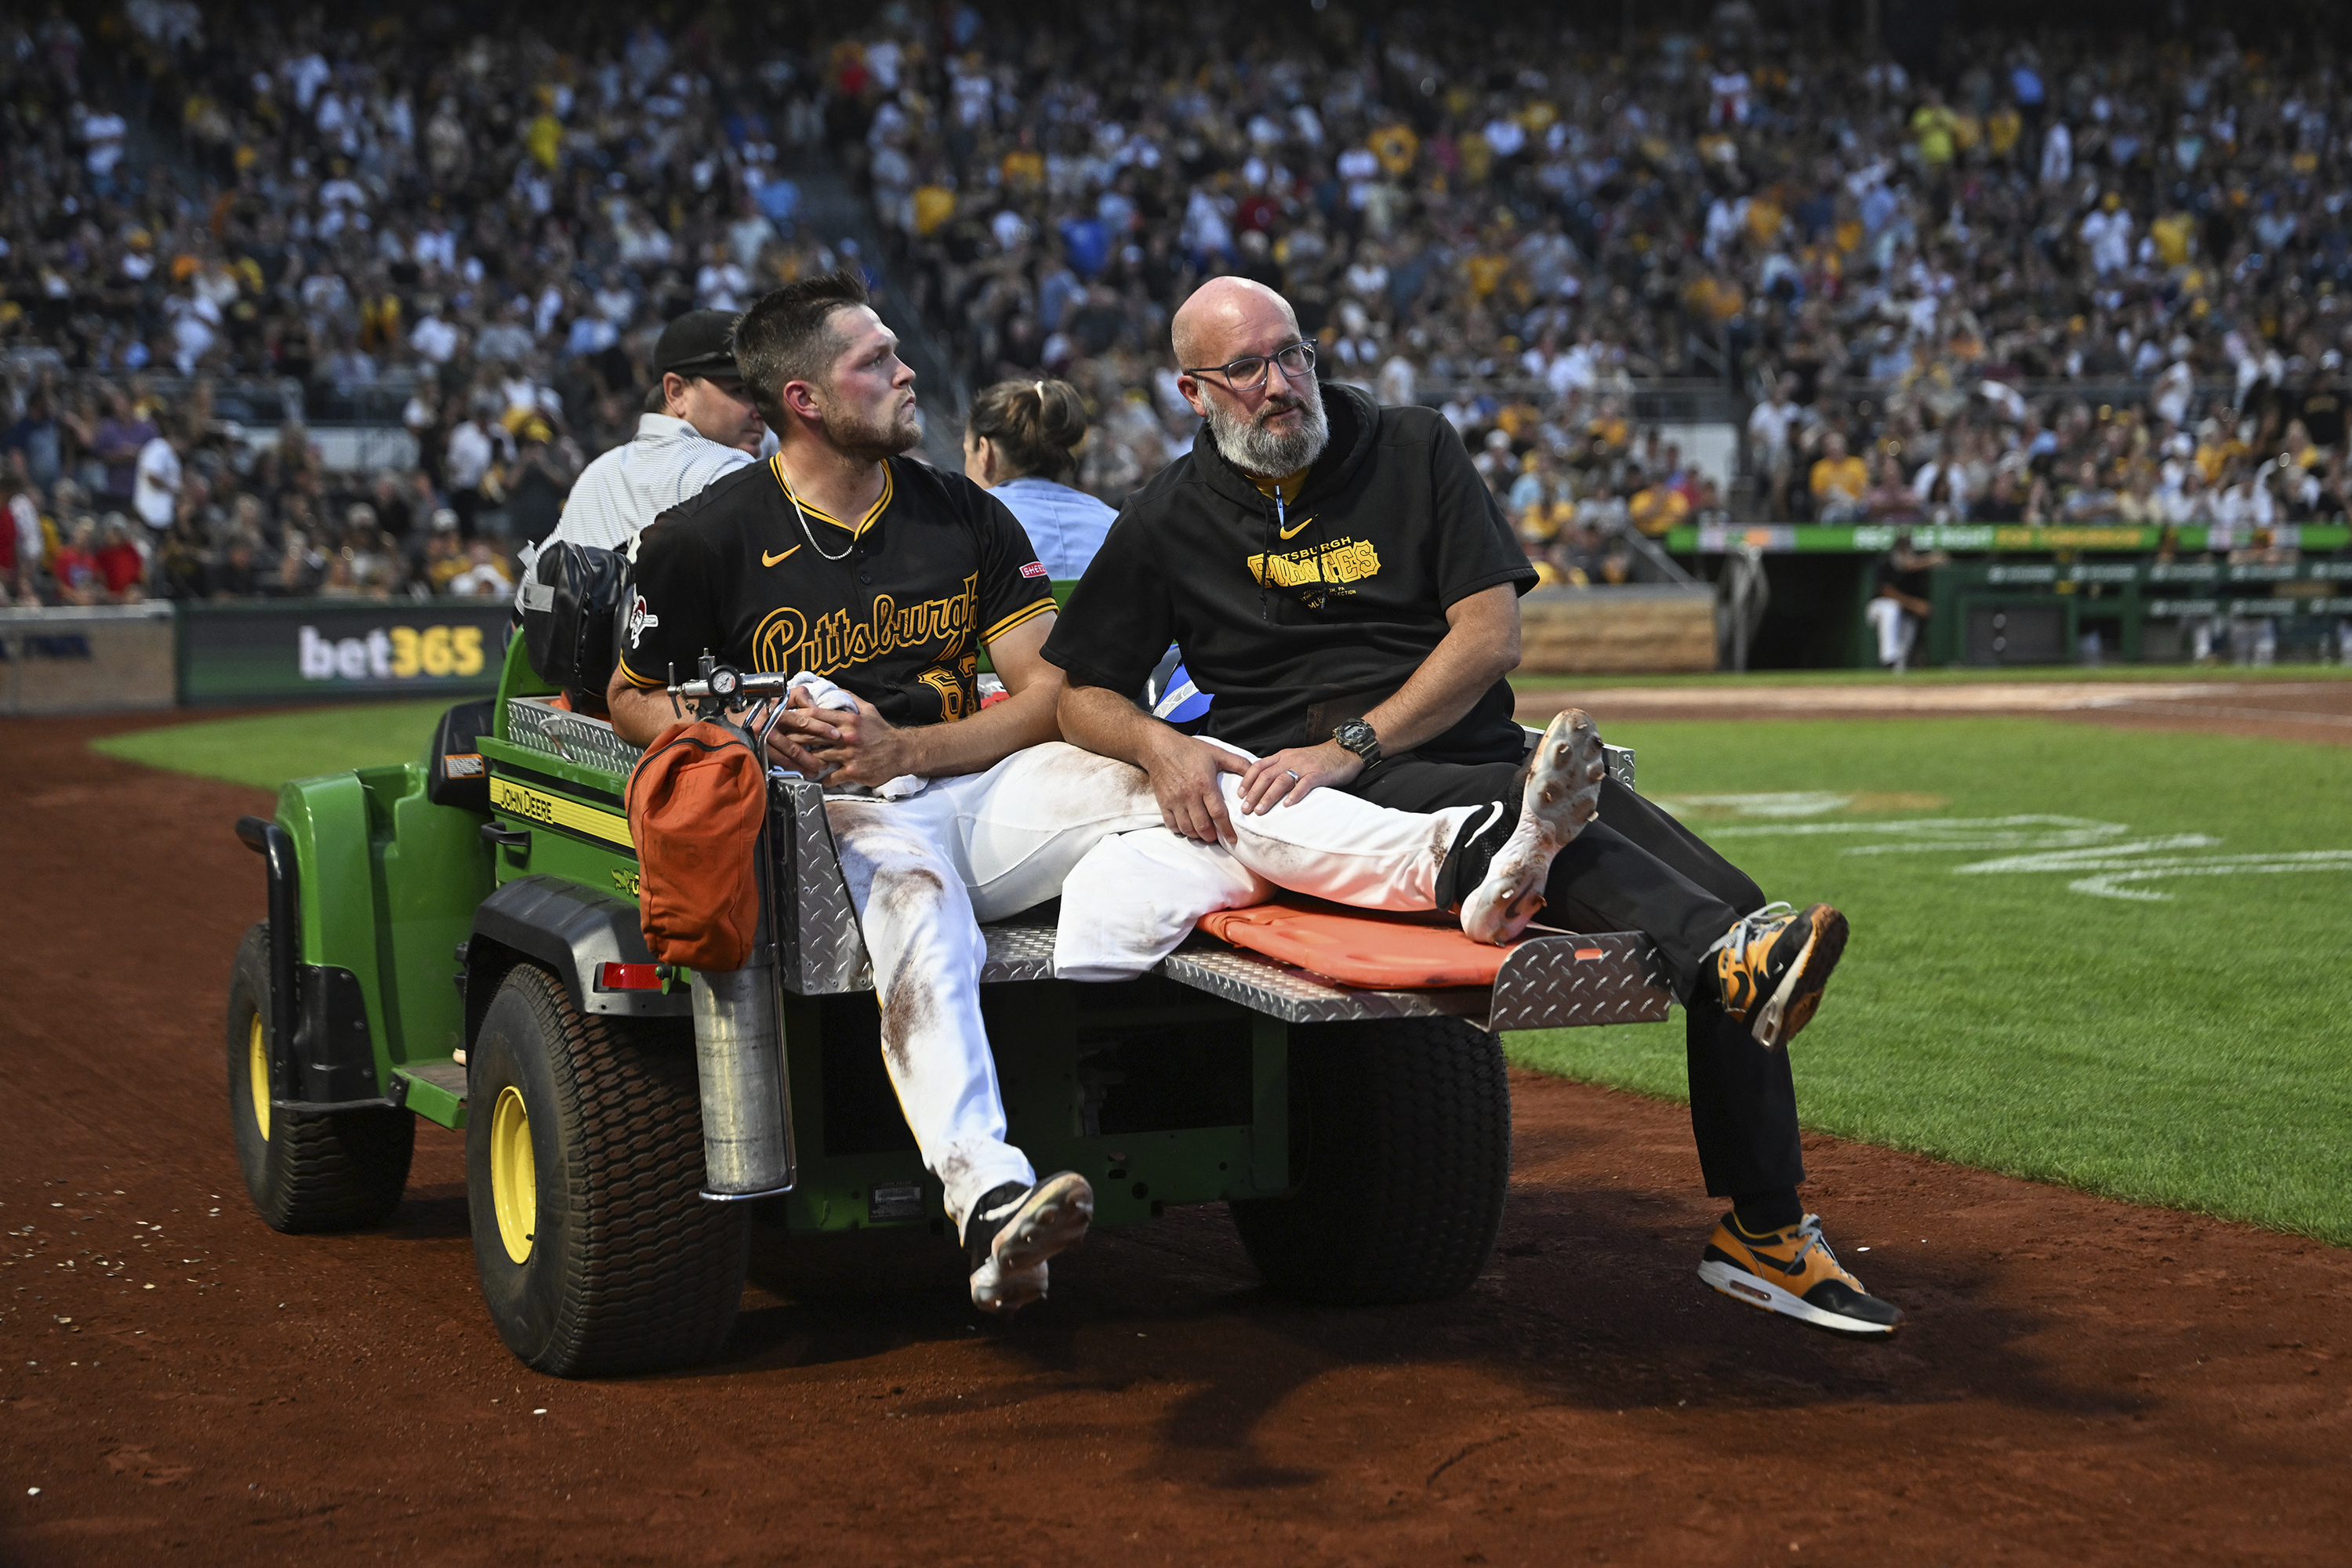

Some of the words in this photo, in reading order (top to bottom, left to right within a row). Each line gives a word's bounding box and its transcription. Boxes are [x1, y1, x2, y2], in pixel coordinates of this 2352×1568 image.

[298, 625, 484, 681] bet365
[752, 570, 979, 680] Pittsburgh
[500, 782, 524, 811] JOHN
[524, 789, 552, 821] DEERE
